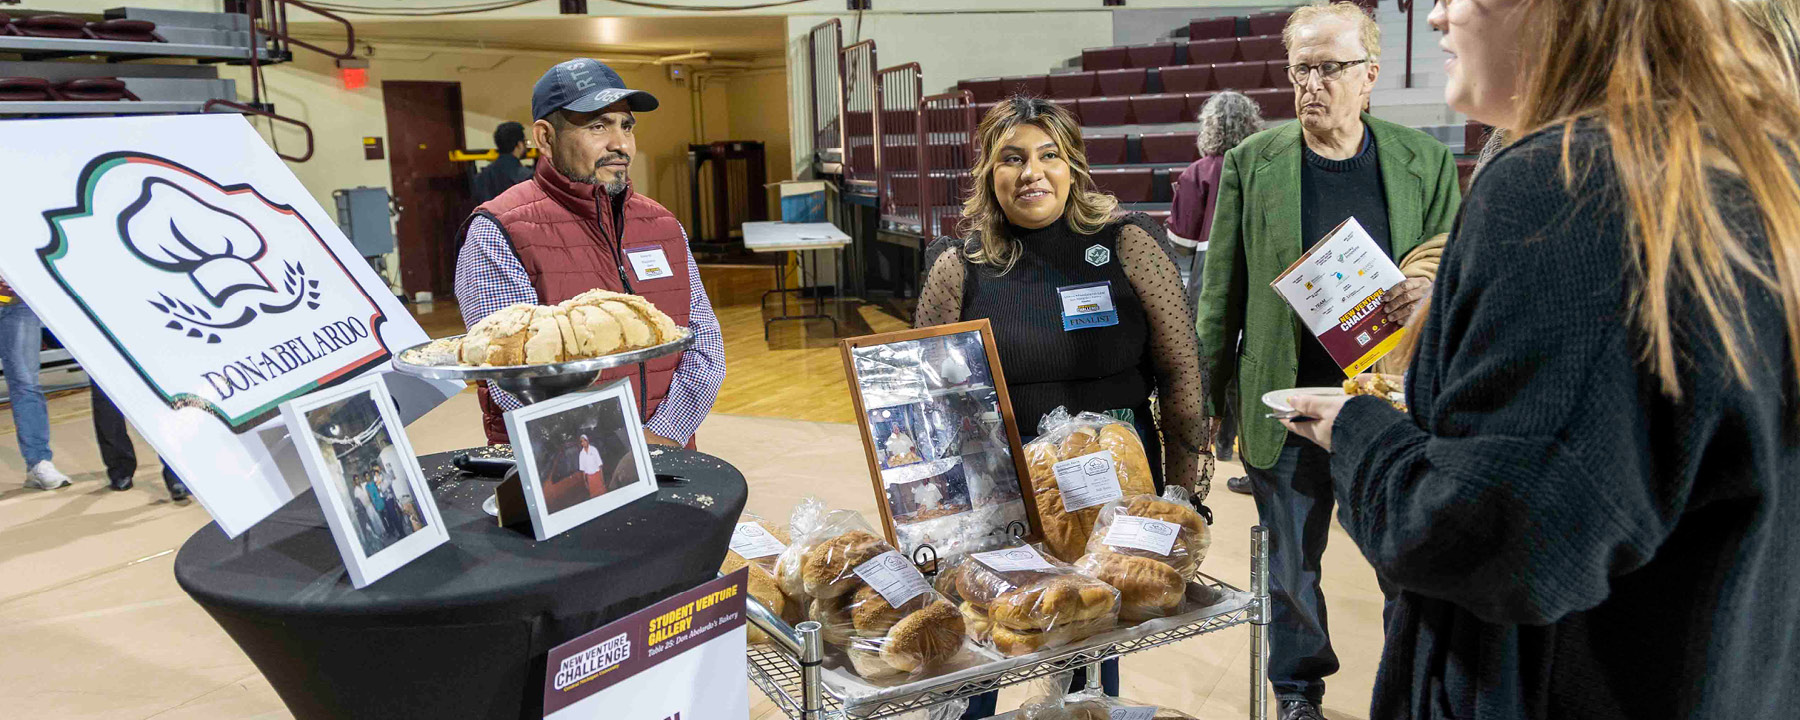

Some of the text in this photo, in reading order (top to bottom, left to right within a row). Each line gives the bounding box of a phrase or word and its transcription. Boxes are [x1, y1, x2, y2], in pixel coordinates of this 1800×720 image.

[1070, 315, 1110, 326] FINALIST
[1340, 309, 1356, 323] NEW
[1355, 289, 1385, 311] VENTURE
[200, 316, 369, 401] DON-ABELARDO
[649, 584, 738, 632] STUDENT VENTURE
[648, 616, 692, 646] GALLERY
[648, 612, 738, 657] Table 25: Don Abelardo's Bakery
[557, 644, 628, 687] CHALLENGE
[562, 636, 625, 671] NEW VENTURE
[563, 681, 580, 692] Central
[599, 664, 620, 676] University
